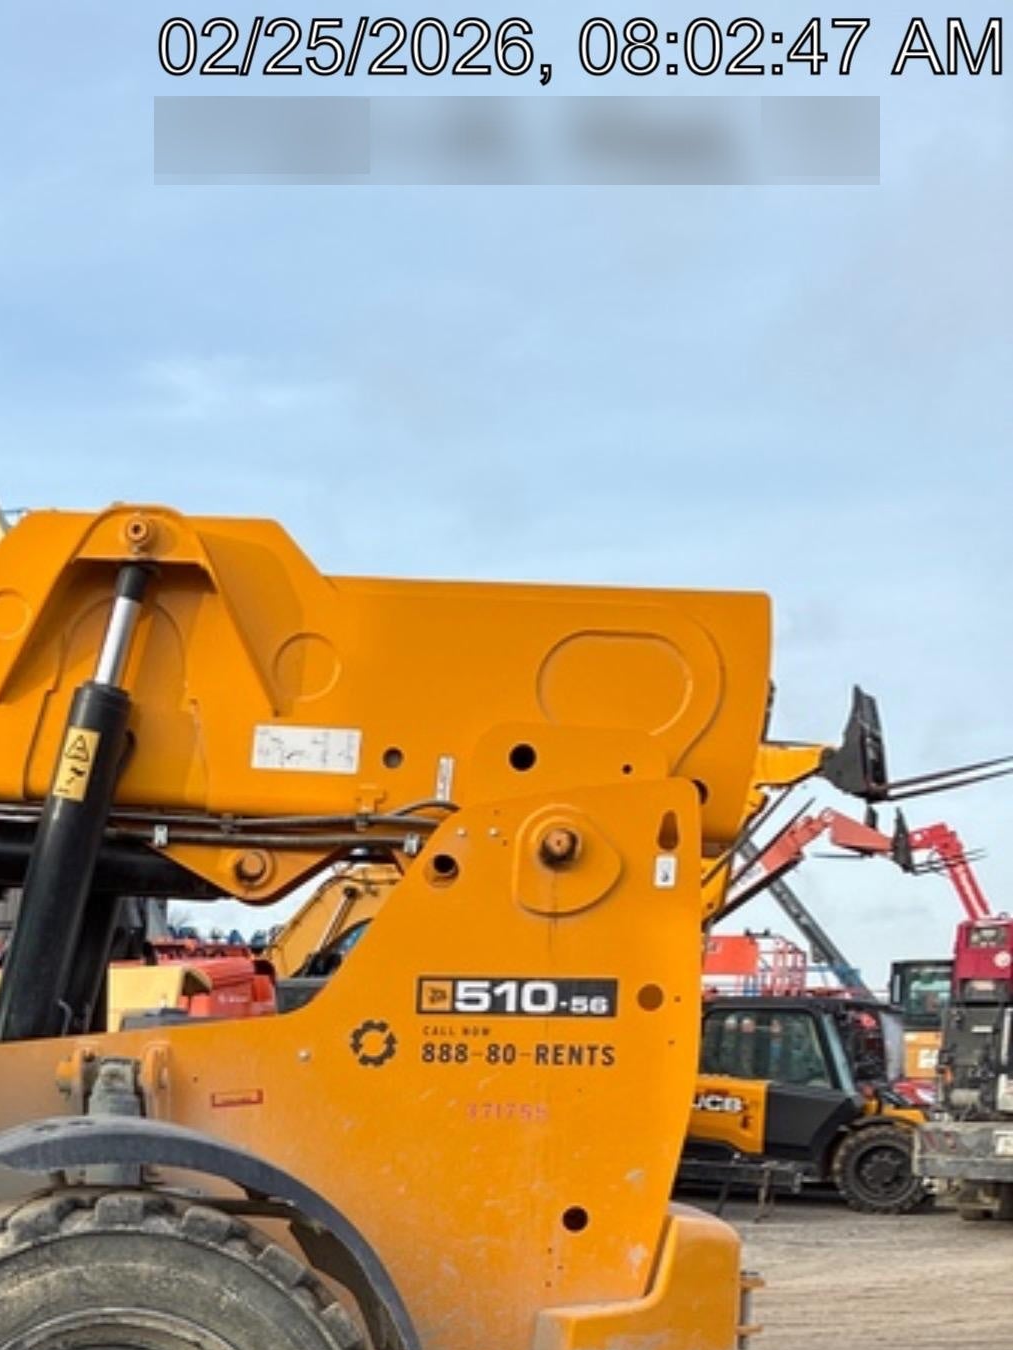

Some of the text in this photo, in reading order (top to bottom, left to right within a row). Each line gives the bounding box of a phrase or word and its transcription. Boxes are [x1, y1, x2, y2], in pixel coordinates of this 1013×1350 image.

[422, 1026, 491, 1037] CALL NOW
[421, 1043, 616, 1066] 888-80-RENTS
